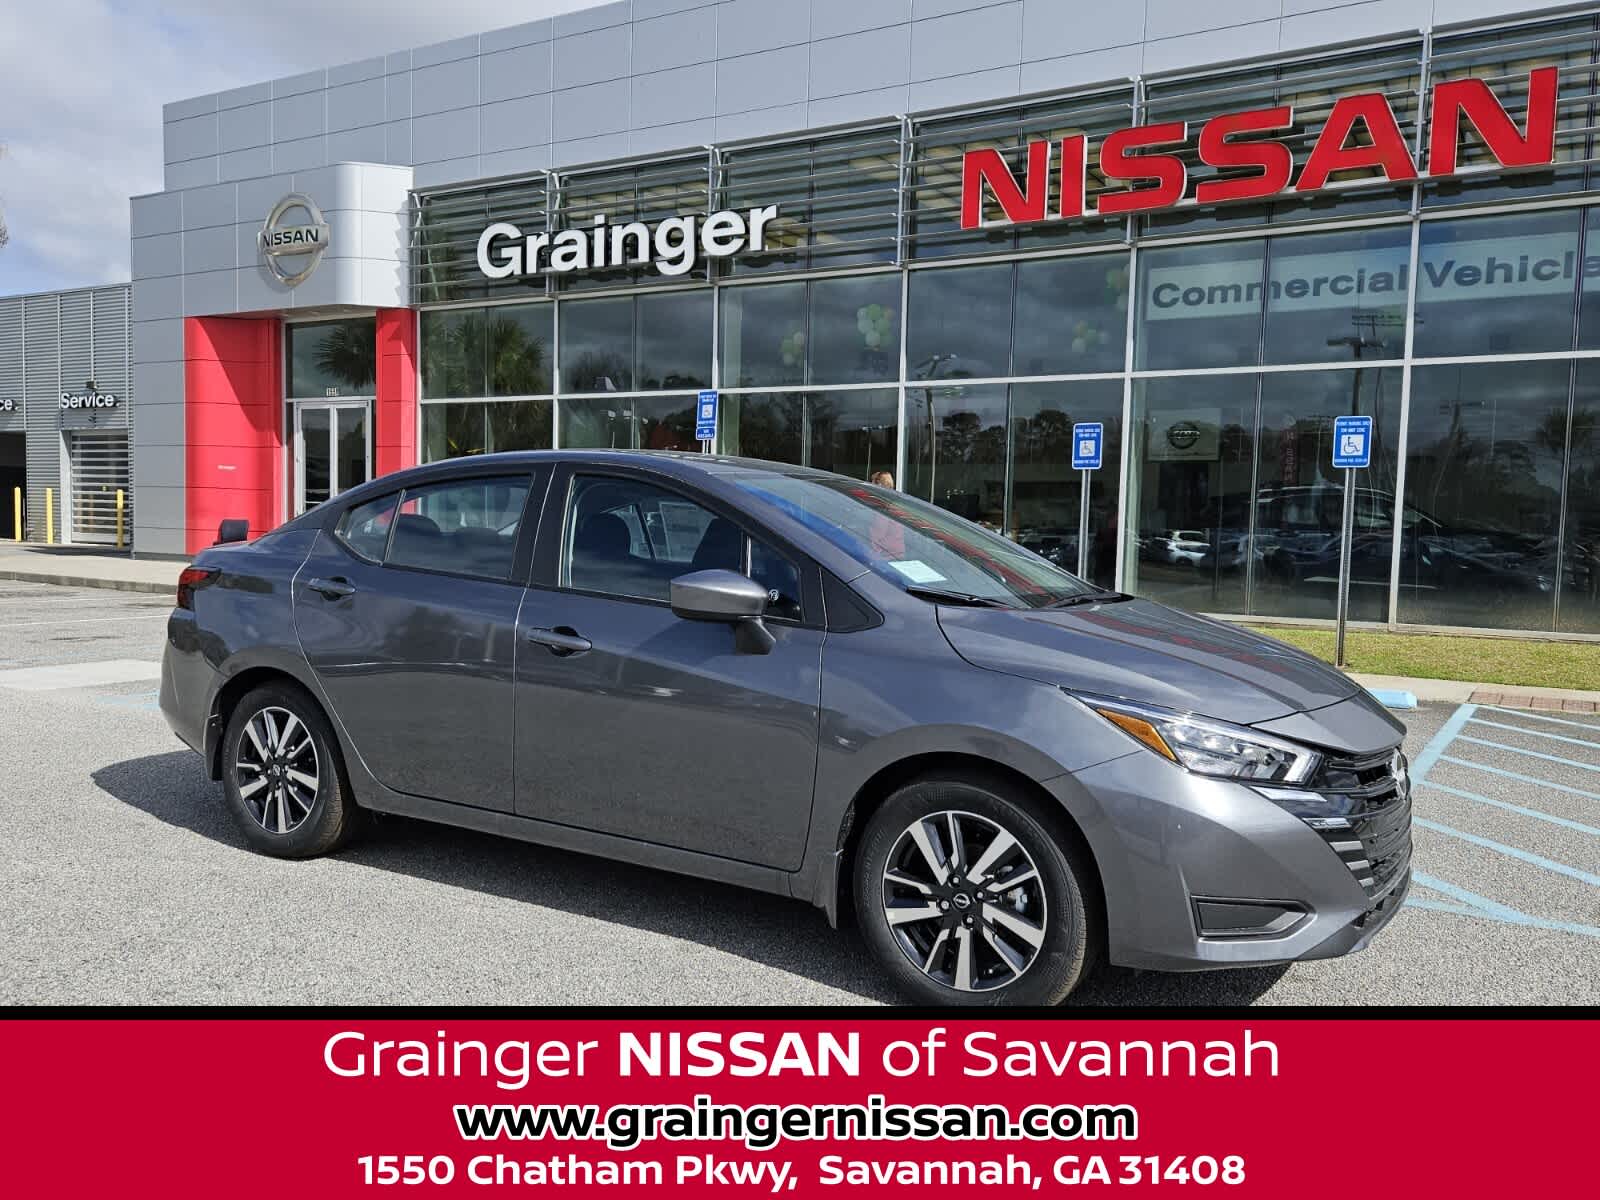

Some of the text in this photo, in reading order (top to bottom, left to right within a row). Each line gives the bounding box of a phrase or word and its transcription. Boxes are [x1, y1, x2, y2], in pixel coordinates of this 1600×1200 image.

[961, 66, 1558, 229] NISSAN
[262, 228, 319, 248] NISSAN
[476, 204, 778, 279] Grainger
[1152, 264, 1408, 309] Commercial
[60, 391, 120, 409] Service.
